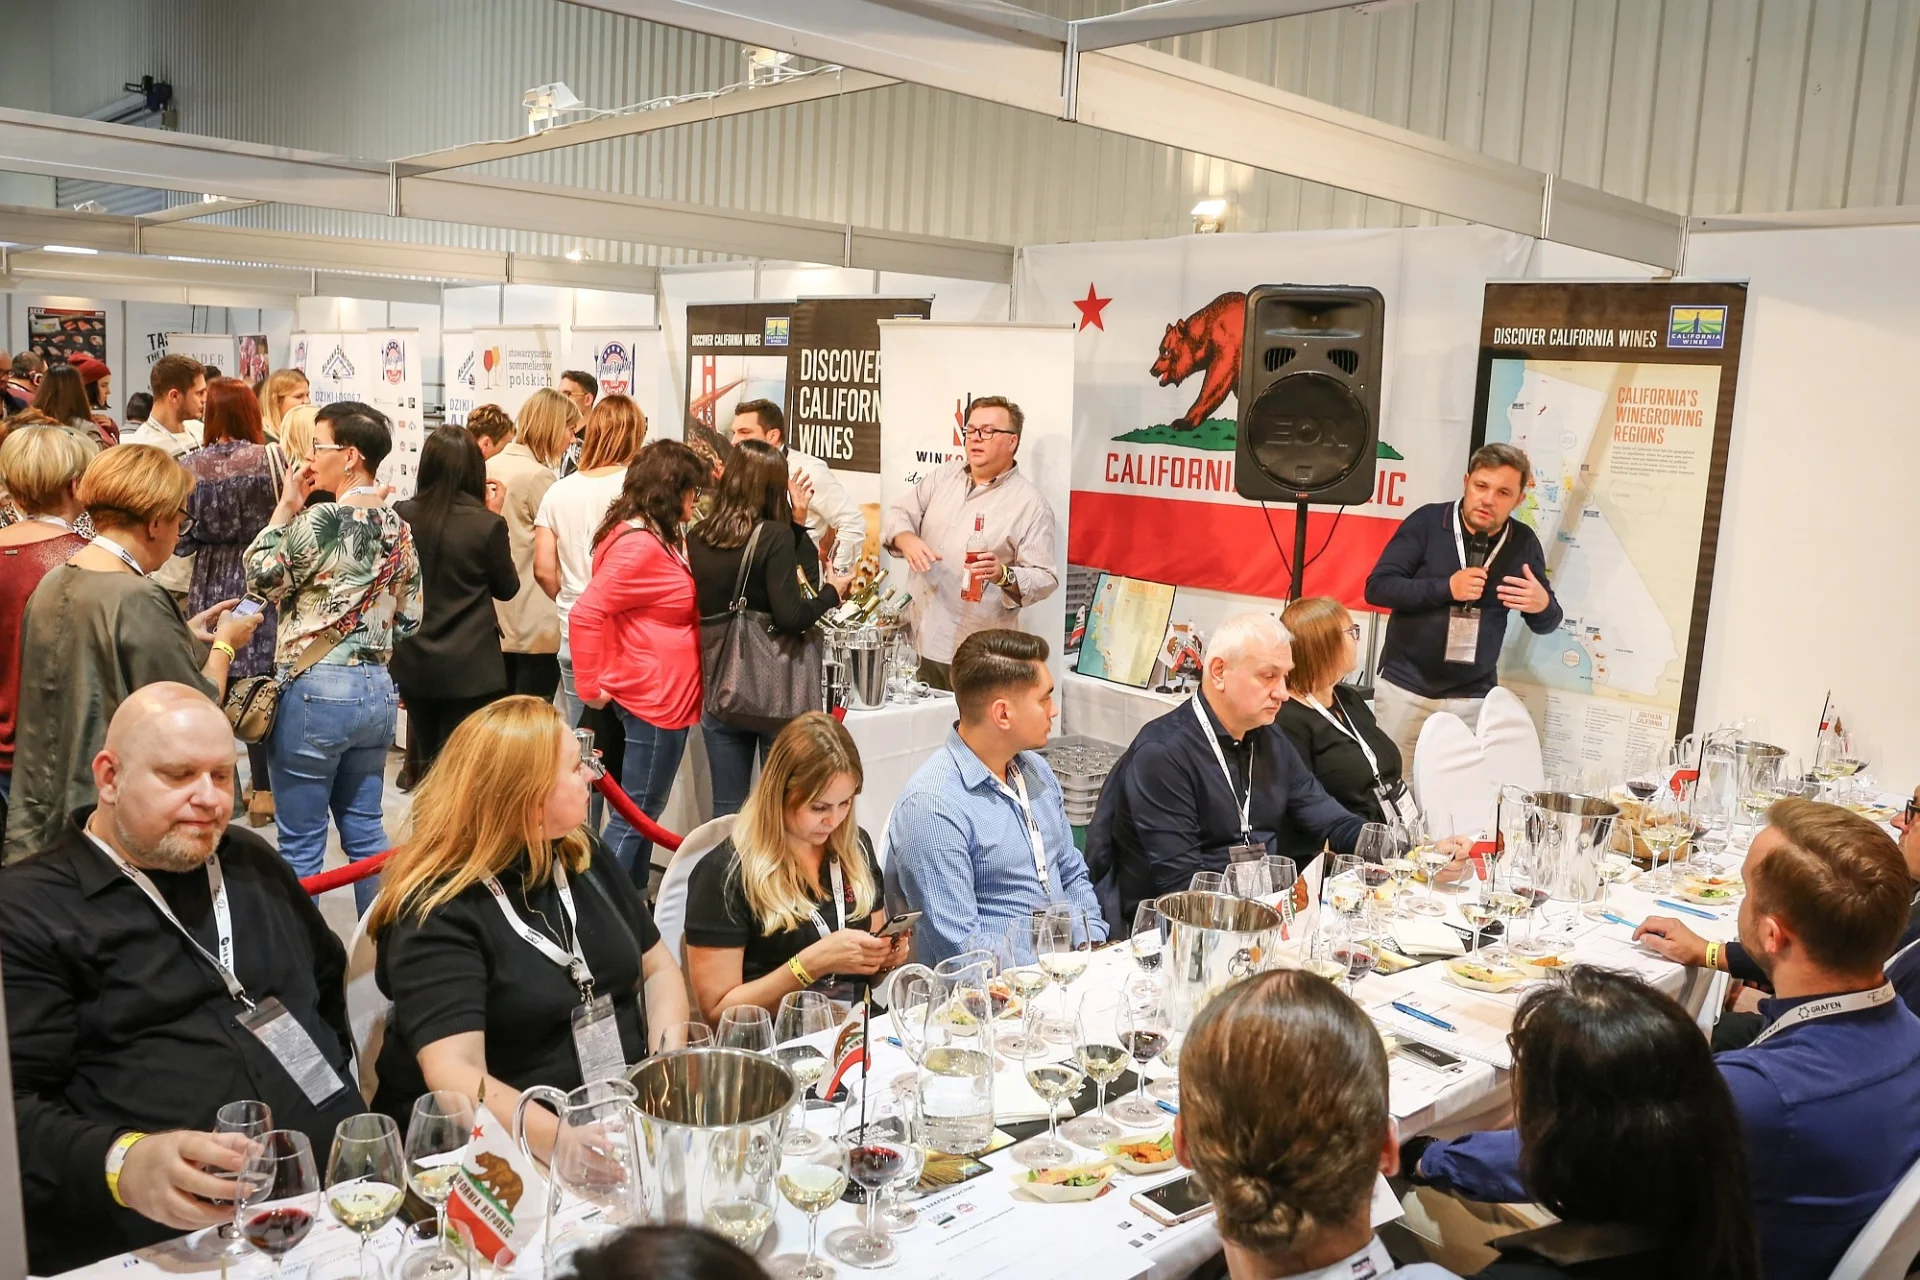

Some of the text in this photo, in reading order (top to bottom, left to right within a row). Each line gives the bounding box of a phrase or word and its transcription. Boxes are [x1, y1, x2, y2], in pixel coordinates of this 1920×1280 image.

[691, 333, 761, 346] DISCOVER CALIFORNIA WINES
[1494, 327, 1658, 348] DISCOVER CALIFORNIA WINES
[508, 361, 553, 371] sommelierów
[509, 373, 553, 388] polskich
[315, 391, 334, 403] DZIKI
[449, 398, 470, 411] DZIKI
[1617, 386, 1698, 407] CALIFORNIA'S
[1615, 407, 1703, 428] WINEGROWING
[798, 424, 854, 460] WINES
[1613, 425, 1664, 444] REGIONS
[1105, 453, 1238, 492] CALIFORNI
[1636, 718, 1663, 727] CALIFORNIA
[1811, 1001, 1842, 1013] GRAFEN
[480, 1204, 513, 1239] REPUBLIC
